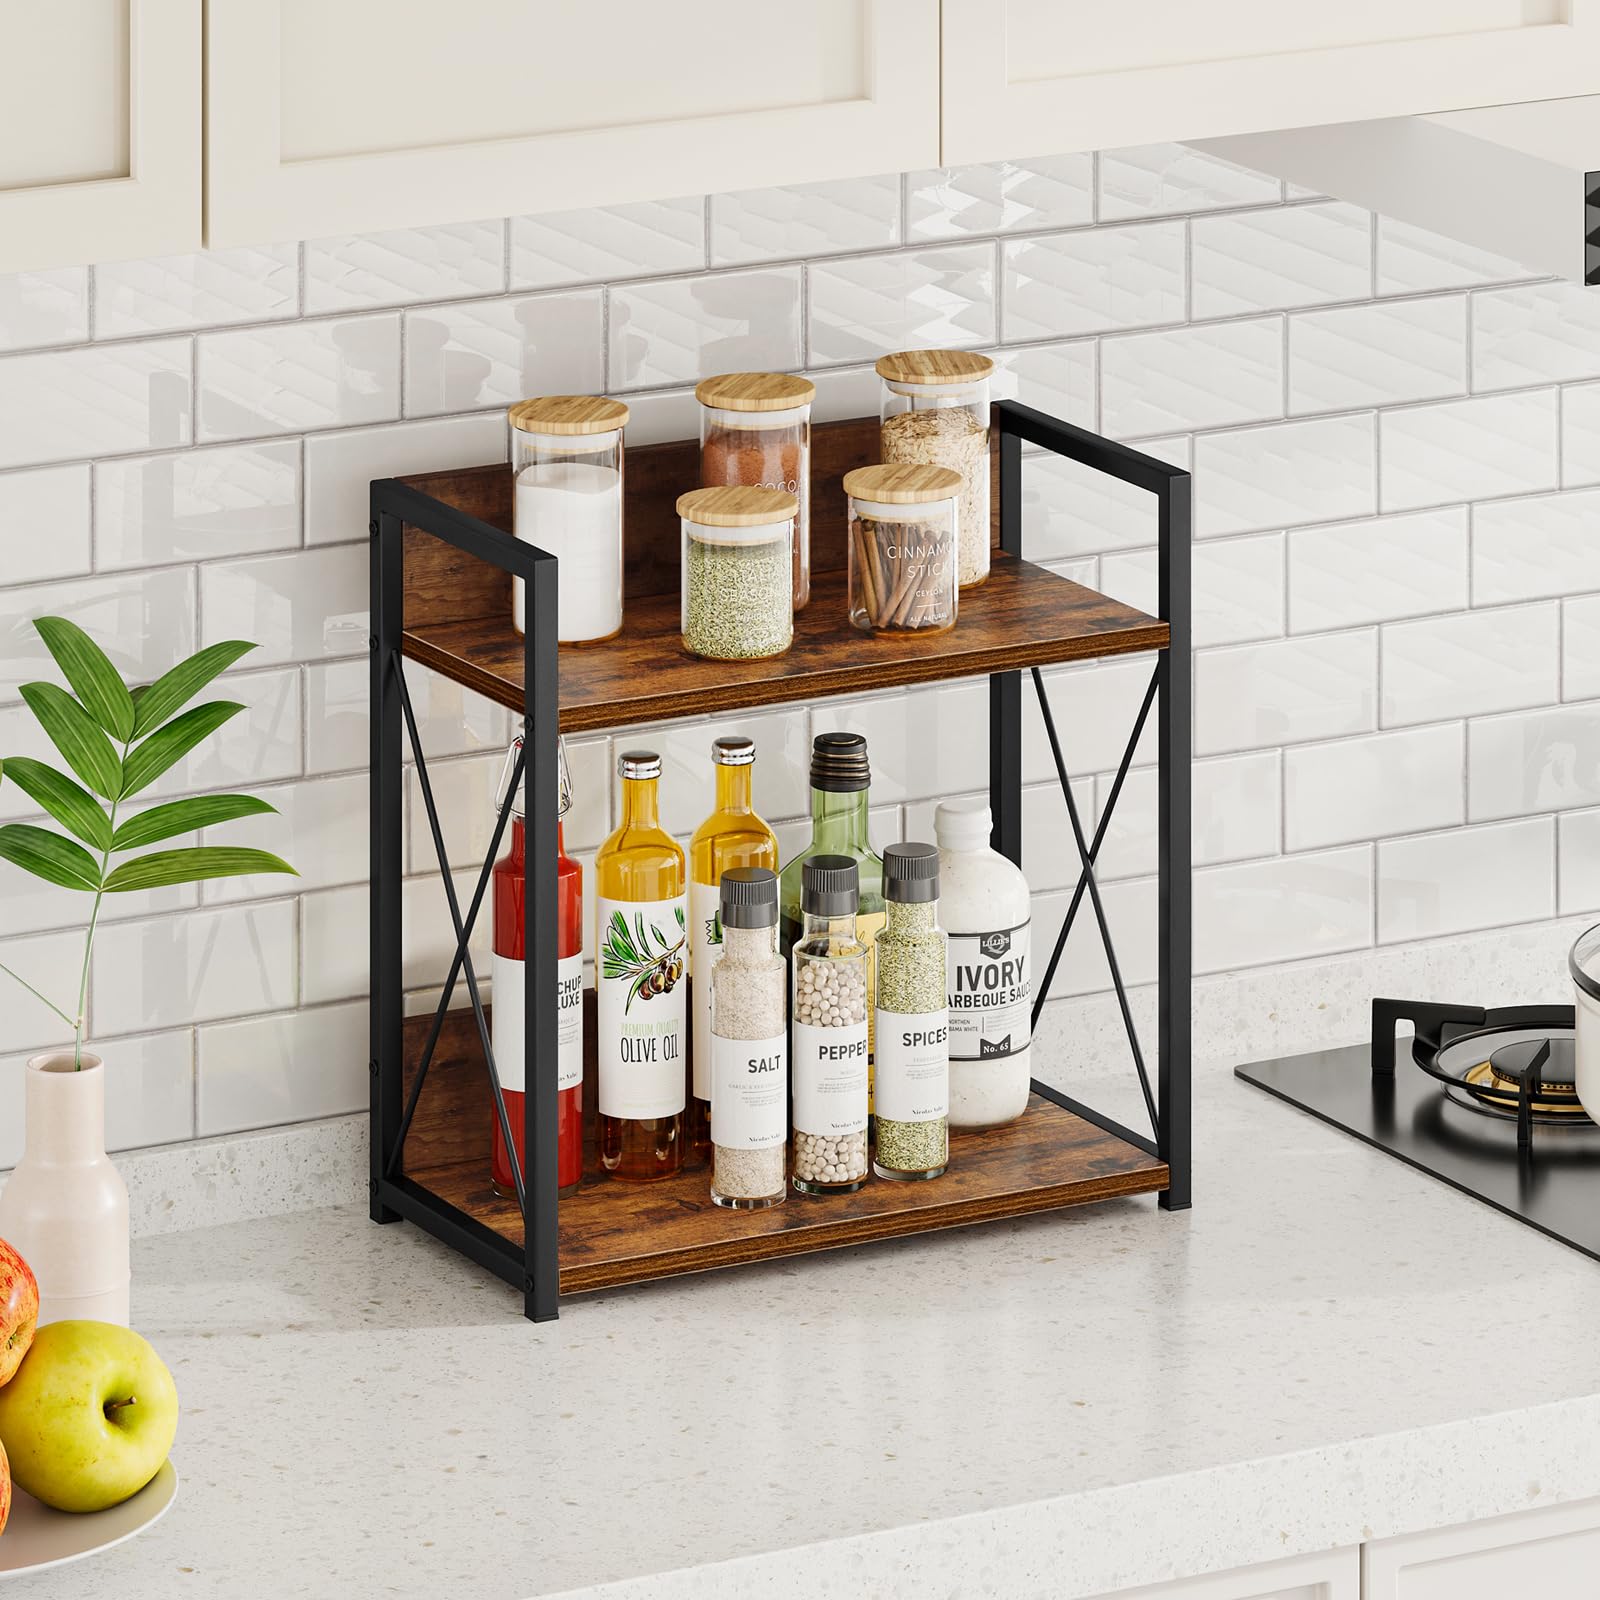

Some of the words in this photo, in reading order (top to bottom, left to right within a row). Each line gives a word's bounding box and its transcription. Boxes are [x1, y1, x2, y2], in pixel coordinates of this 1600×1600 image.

[956, 955, 1025, 992] IVORY
[902, 1026, 948, 1047] SPICES
[620, 1037, 658, 1063] OLIVE
[663, 1033, 679, 1061] OIL
[818, 1039, 867, 1060] PEPPER
[983, 1045, 998, 1054] No.
[999, 1042, 1009, 1051] 65
[748, 1055, 781, 1074] SALT
